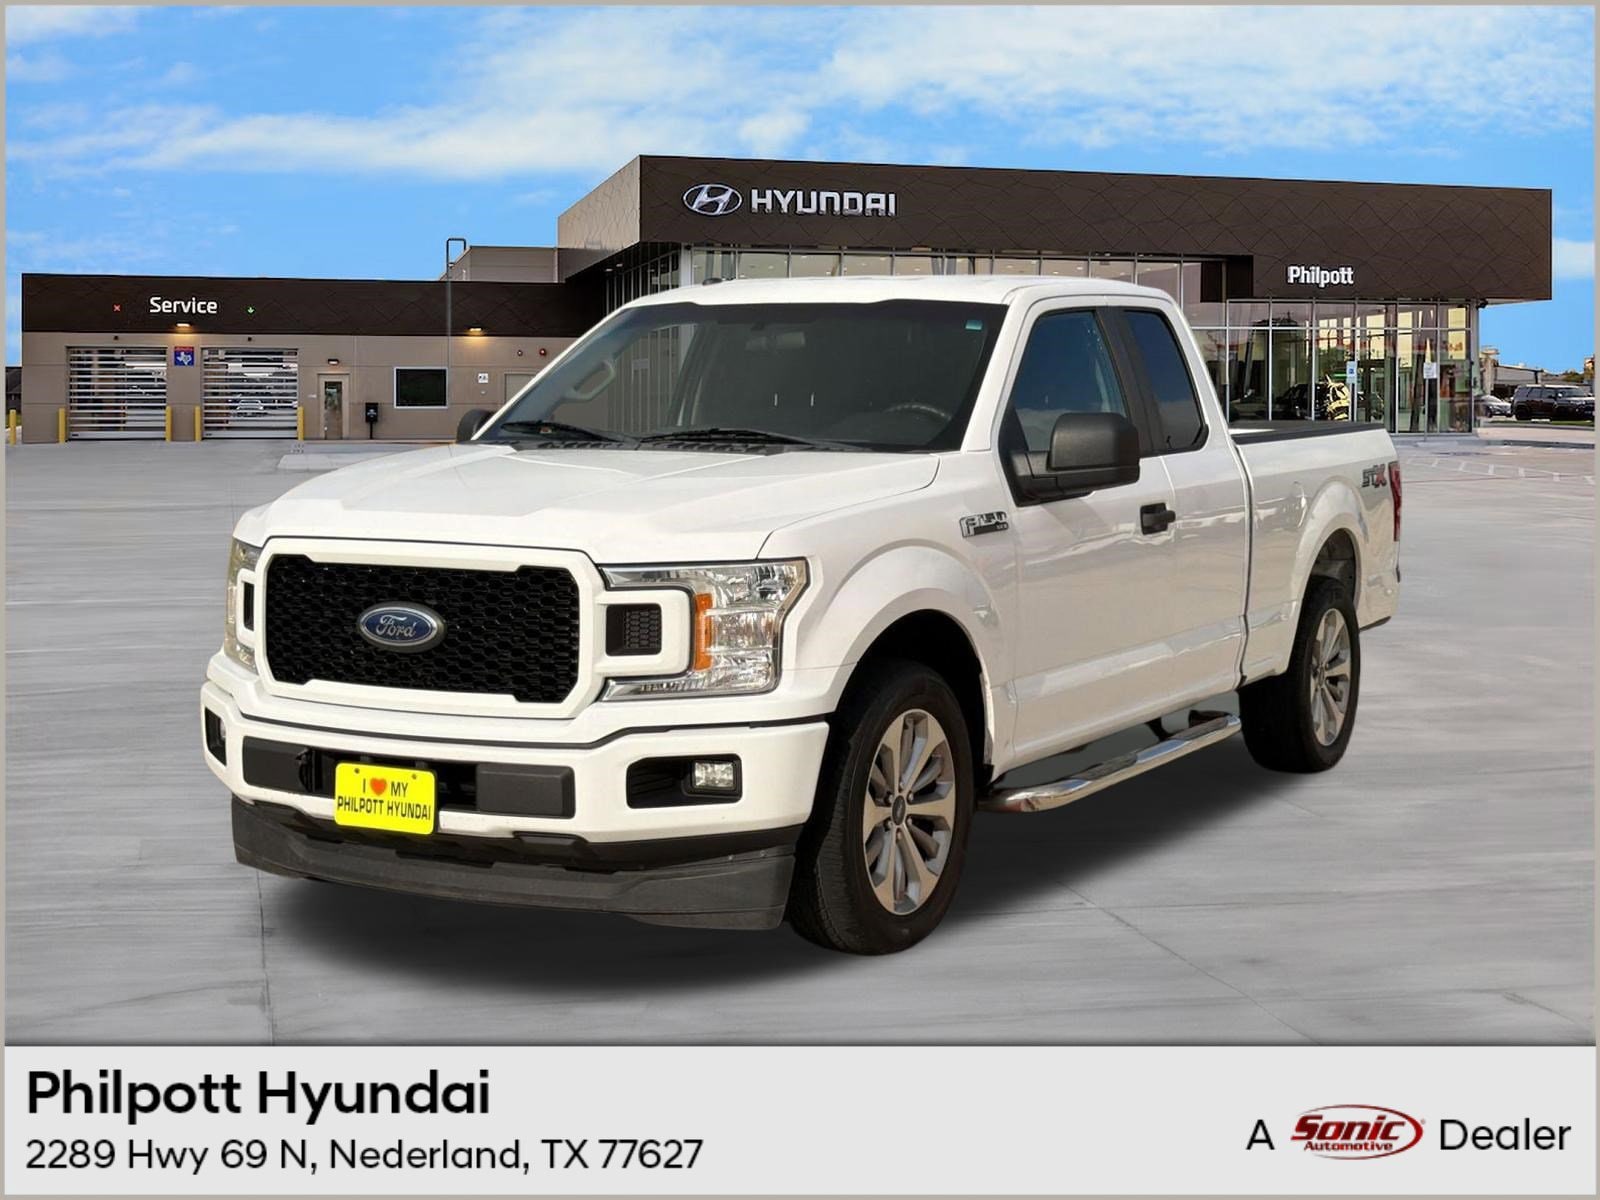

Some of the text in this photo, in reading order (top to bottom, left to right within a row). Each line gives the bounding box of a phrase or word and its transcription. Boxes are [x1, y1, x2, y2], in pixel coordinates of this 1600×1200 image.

[751, 188, 896, 216] HYUNDAI
[1287, 265, 1354, 288] Philpott
[149, 296, 218, 315] Service
[1361, 464, 1388, 488] STX
[375, 614, 417, 638] Ford
[362, 778, 409, 797] I MY
[337, 796, 432, 820] PHILPOTT HYUNDAI
